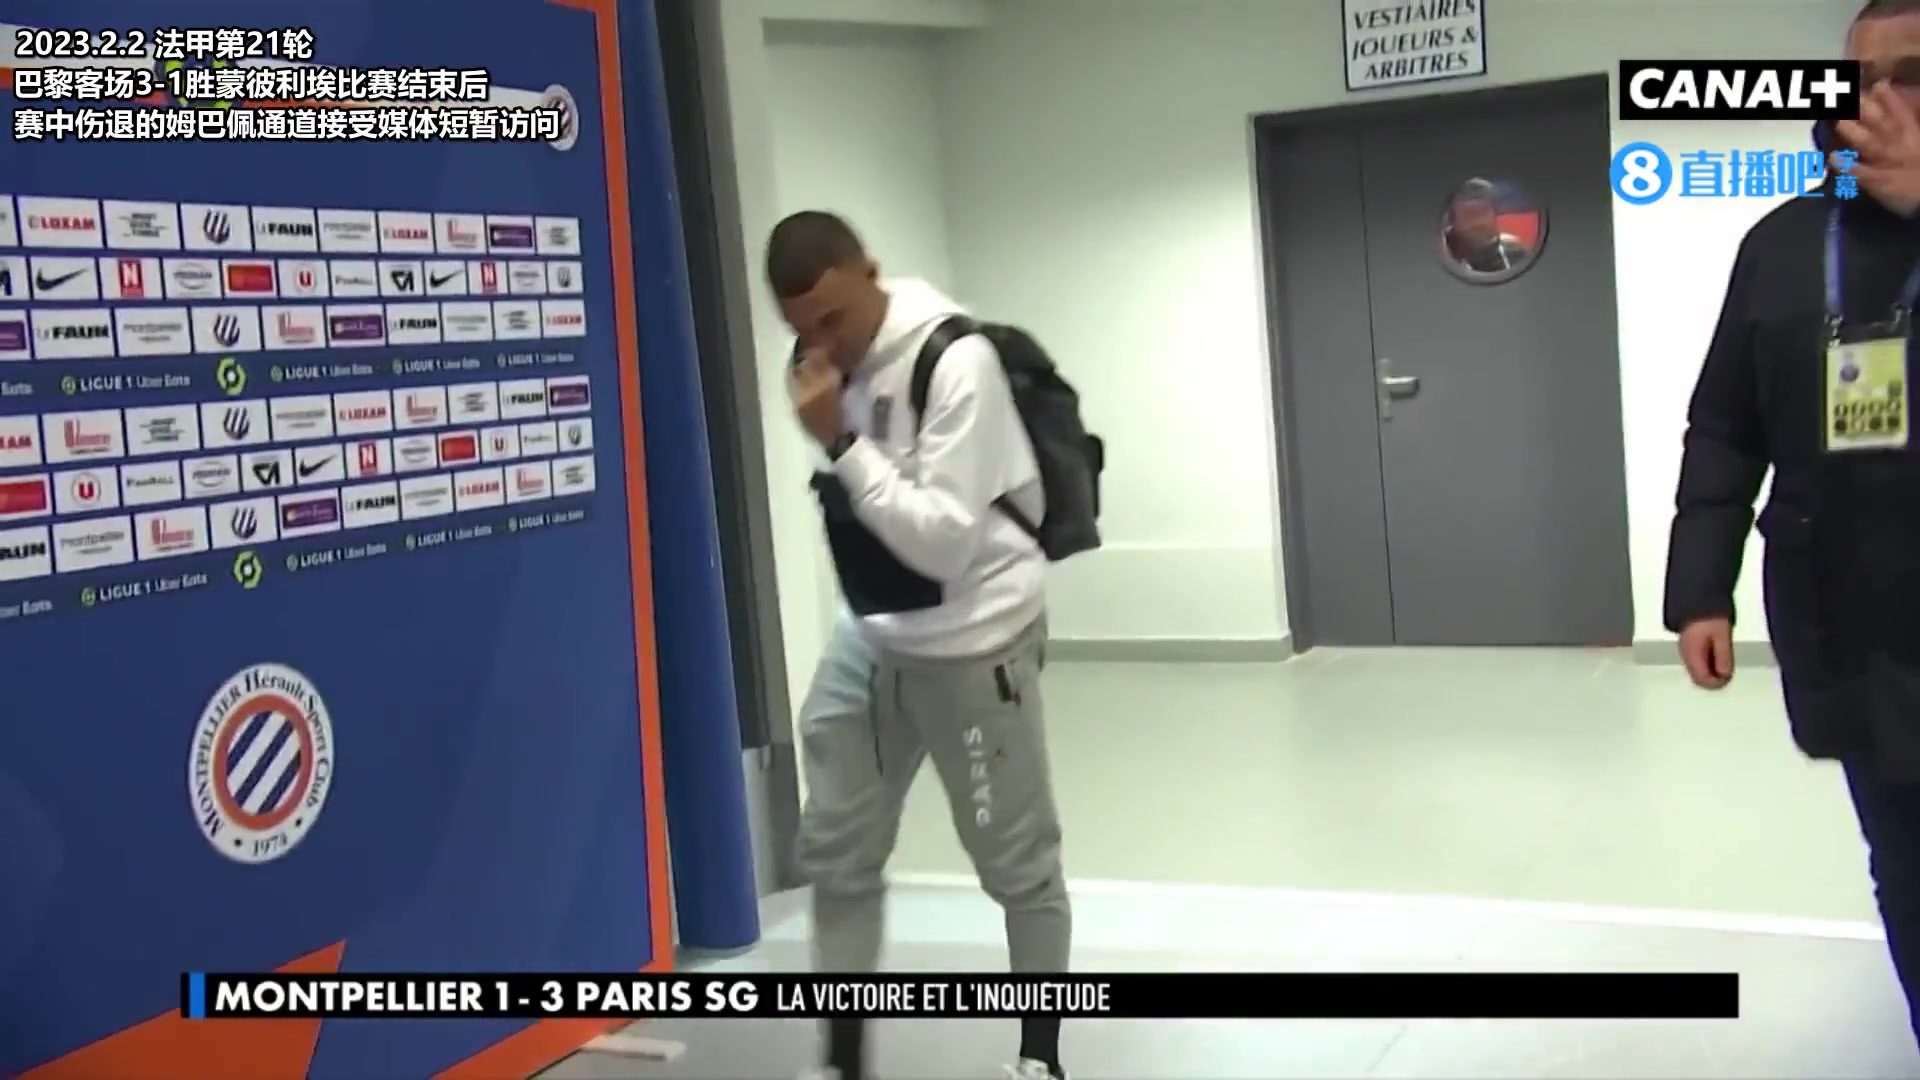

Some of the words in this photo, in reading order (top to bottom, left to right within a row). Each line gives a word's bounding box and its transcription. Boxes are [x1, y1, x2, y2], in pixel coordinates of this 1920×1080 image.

[1354, 0, 1476, 29] VESTIAIRES
[1352, 26, 1455, 60] JOUEURS
[1461, 25, 1478, 44] &
[1365, 51, 1468, 80] ARBITRES
[285, 366, 320, 381] LIGUE
[404, 359, 434, 374] LIGUE
[80, 374, 123, 392] LIGUE
[301, 549, 334, 568] LIGUE
[100, 582, 142, 601] LIGUE
[245, 668, 306, 699] Hérault
[303, 694, 327, 752] Sport
[195, 684, 242, 838] MONTPELLIER
[307, 757, 330, 809] Club
[964, 725, 992, 828] PARIS
[253, 831, 289, 857] 1974
